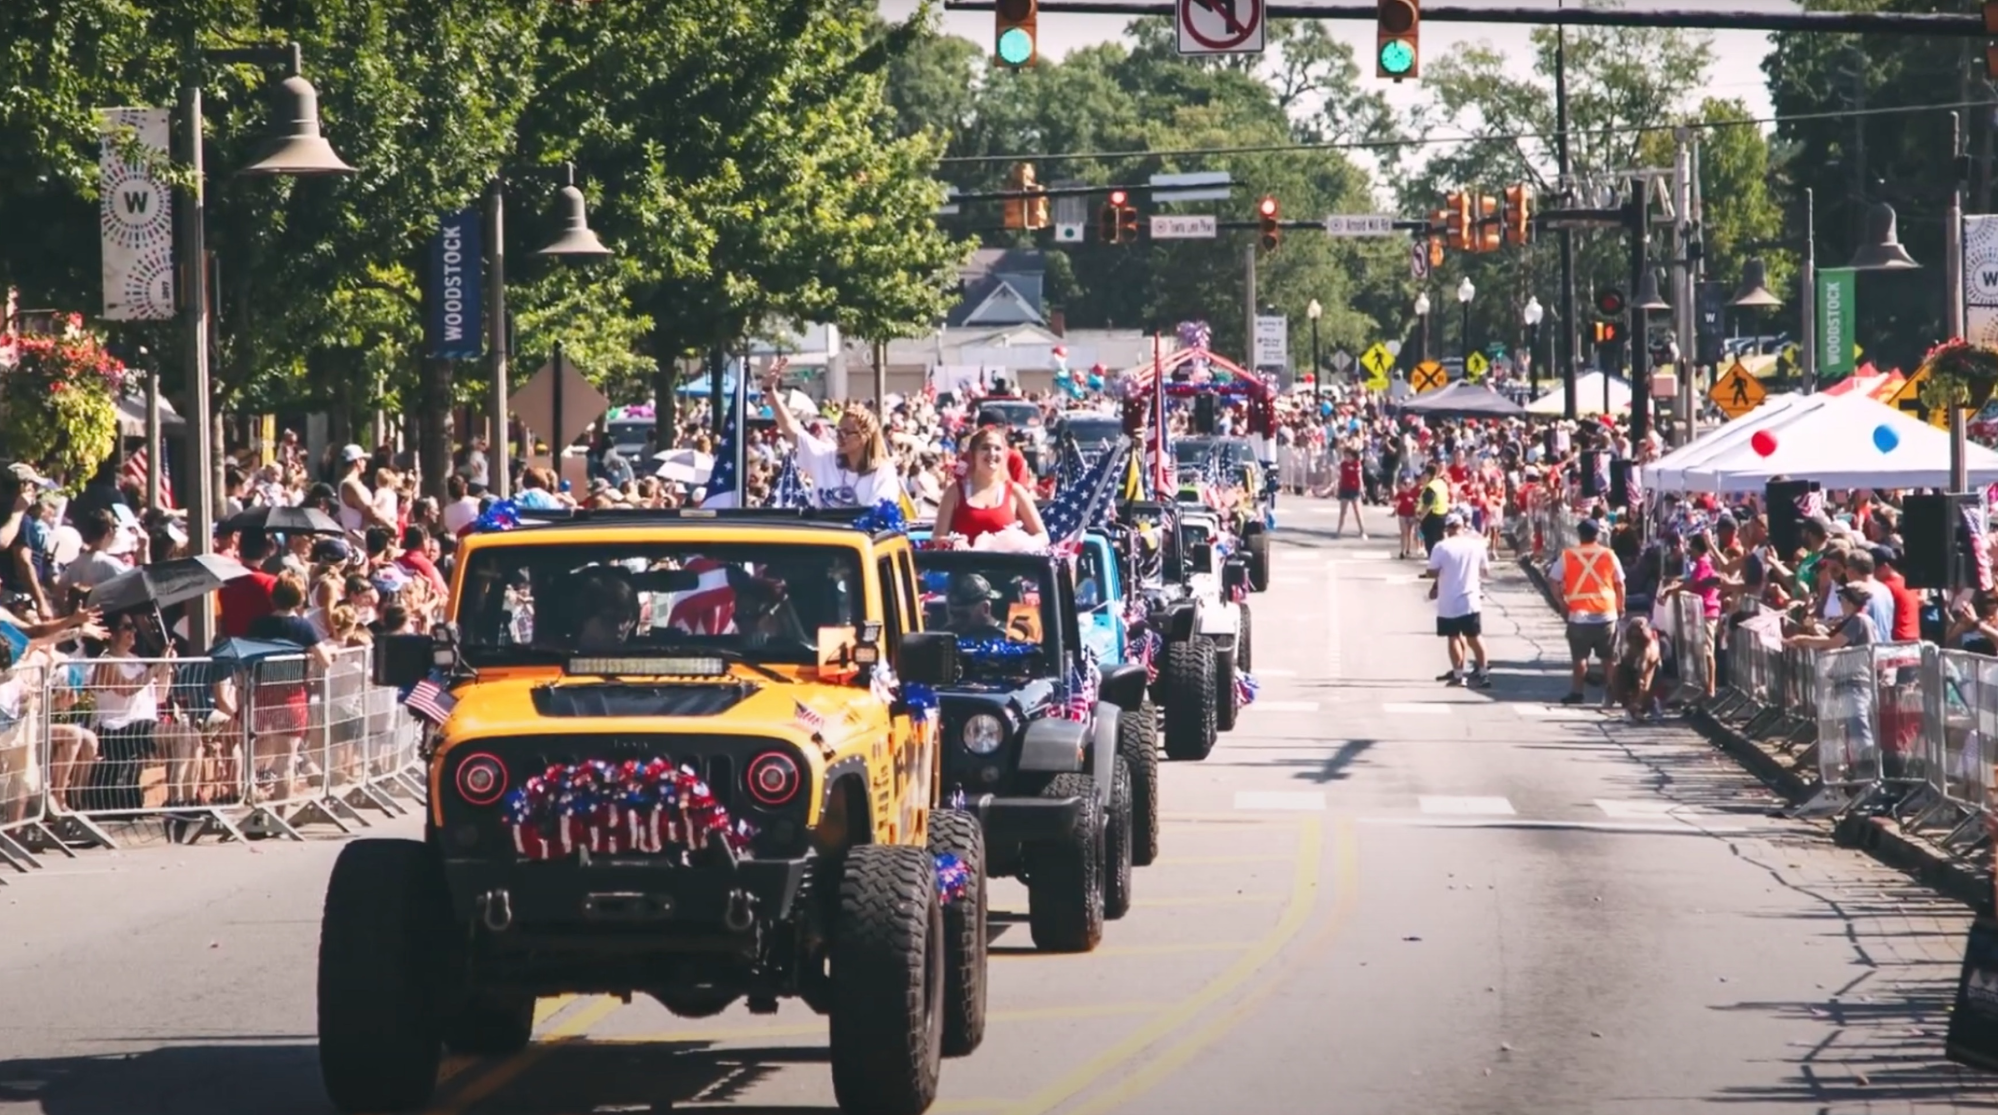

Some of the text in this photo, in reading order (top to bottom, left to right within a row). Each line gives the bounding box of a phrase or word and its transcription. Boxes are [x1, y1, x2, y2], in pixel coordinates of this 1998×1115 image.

[124, 191, 148, 214] W
[443, 226, 462, 341] WOODSTOCK
[1983, 271, 1998, 287] W
[1705, 313, 1715, 323] W
[1827, 282, 1840, 366] WOODSTOCK
[1009, 615, 1030, 642] 5
